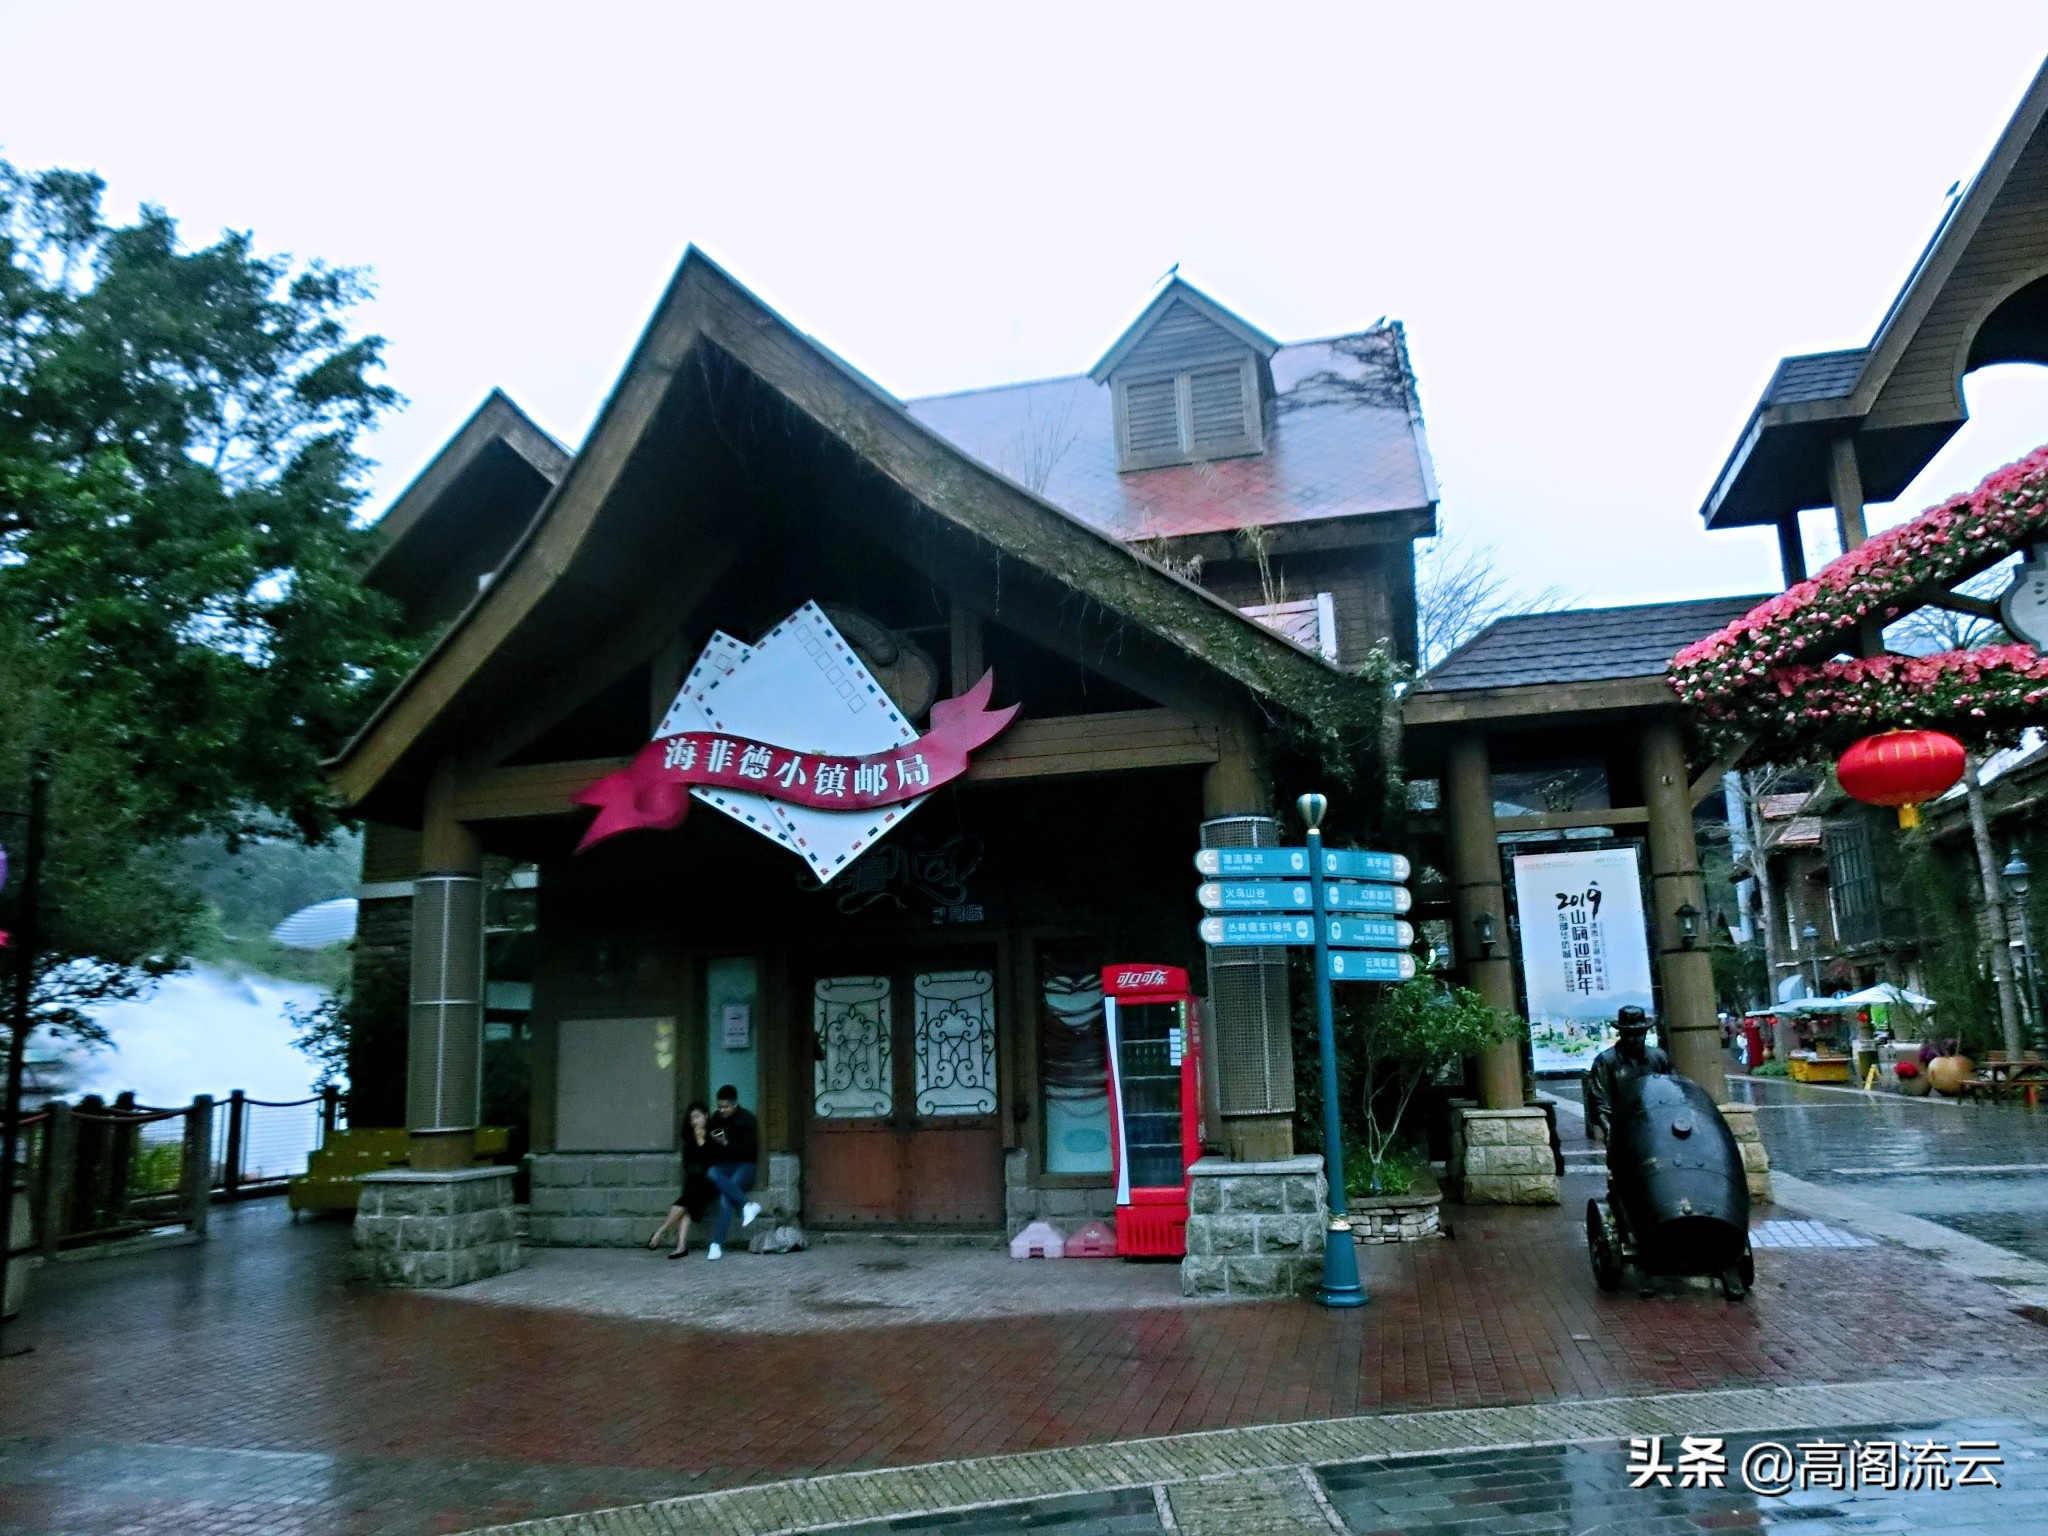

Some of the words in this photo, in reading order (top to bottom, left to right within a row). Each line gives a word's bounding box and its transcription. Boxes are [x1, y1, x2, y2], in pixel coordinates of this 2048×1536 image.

[664, 737, 931, 798] 海菲德小镇邮局
[1225, 887, 1266, 898] 火鸟山谷
[1555, 888, 1602, 921] 2019
[1228, 922, 1292, 933] 丛林缆车1号线
[1570, 908, 1594, 996] 山嗨迎新年
[1116, 969, 1169, 989] 可口可乐
